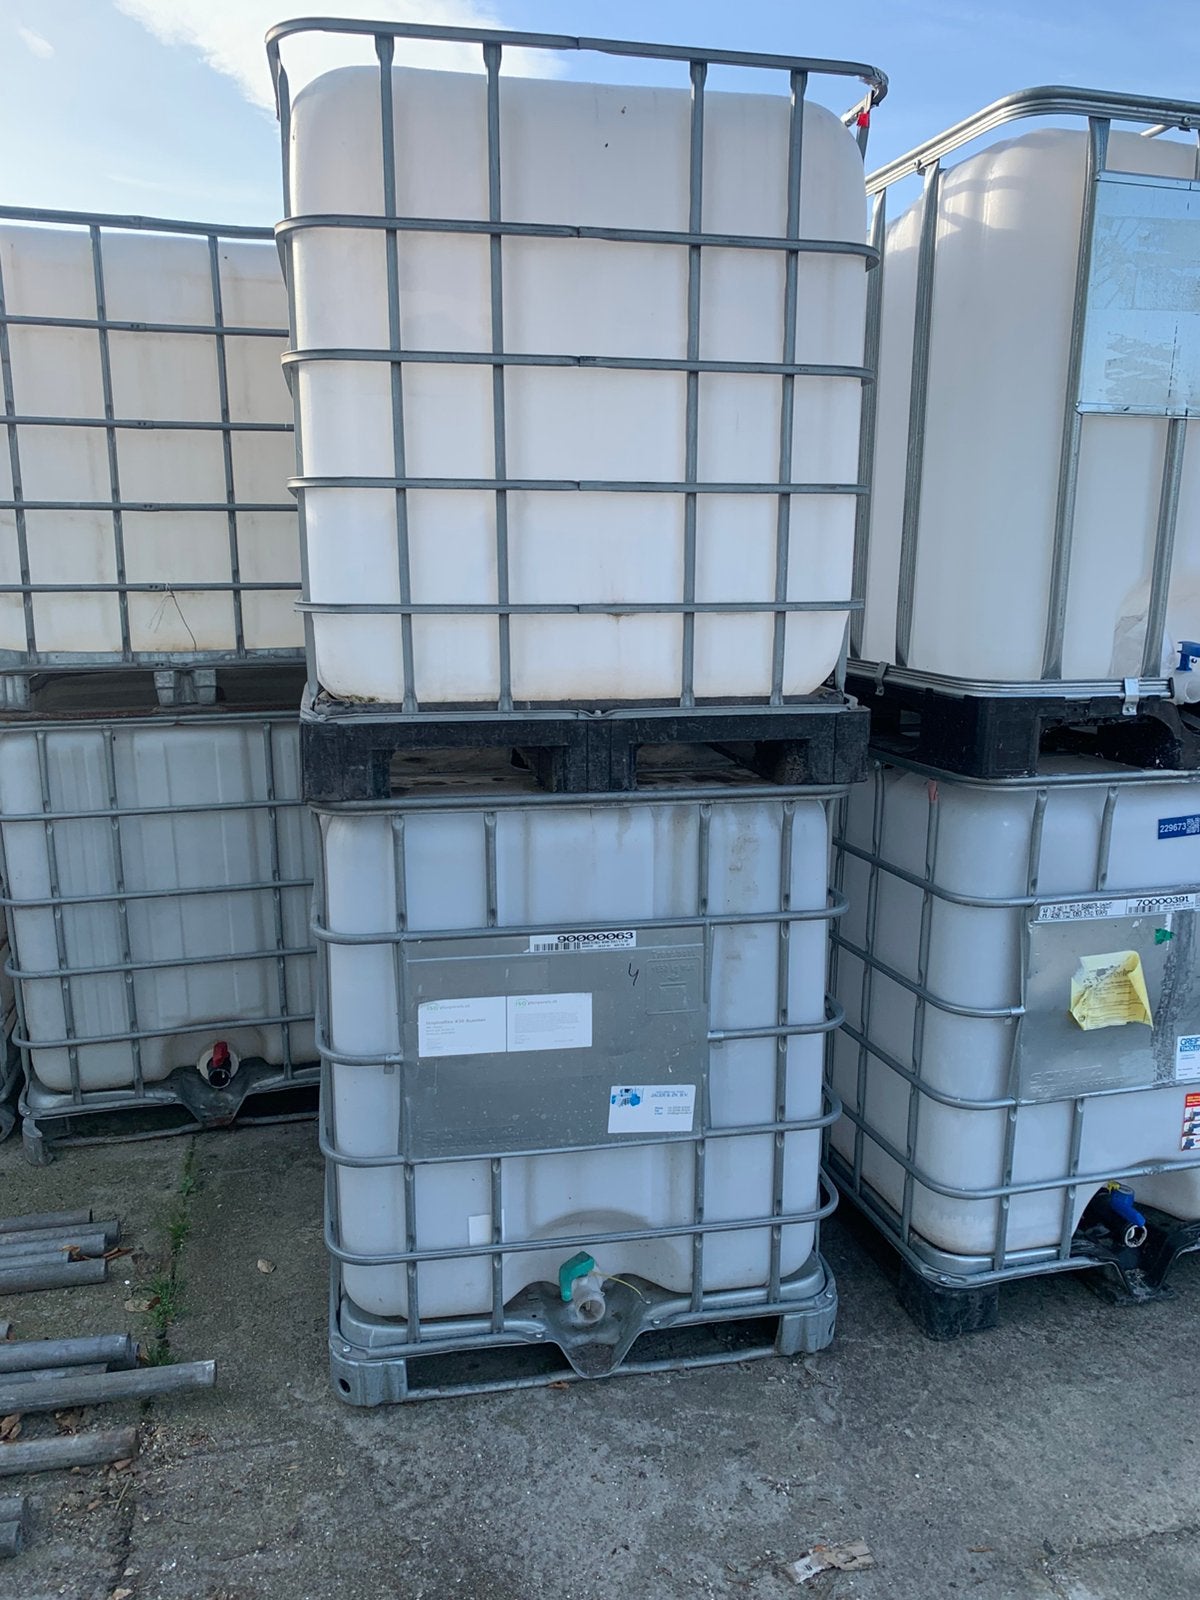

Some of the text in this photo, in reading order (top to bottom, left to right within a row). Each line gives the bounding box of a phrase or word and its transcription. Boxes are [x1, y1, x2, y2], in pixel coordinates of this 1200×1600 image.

[1160, 822, 1187, 833] 229673
[1136, 895, 1189, 906] 70000391
[557, 931, 634, 943] 90000063
